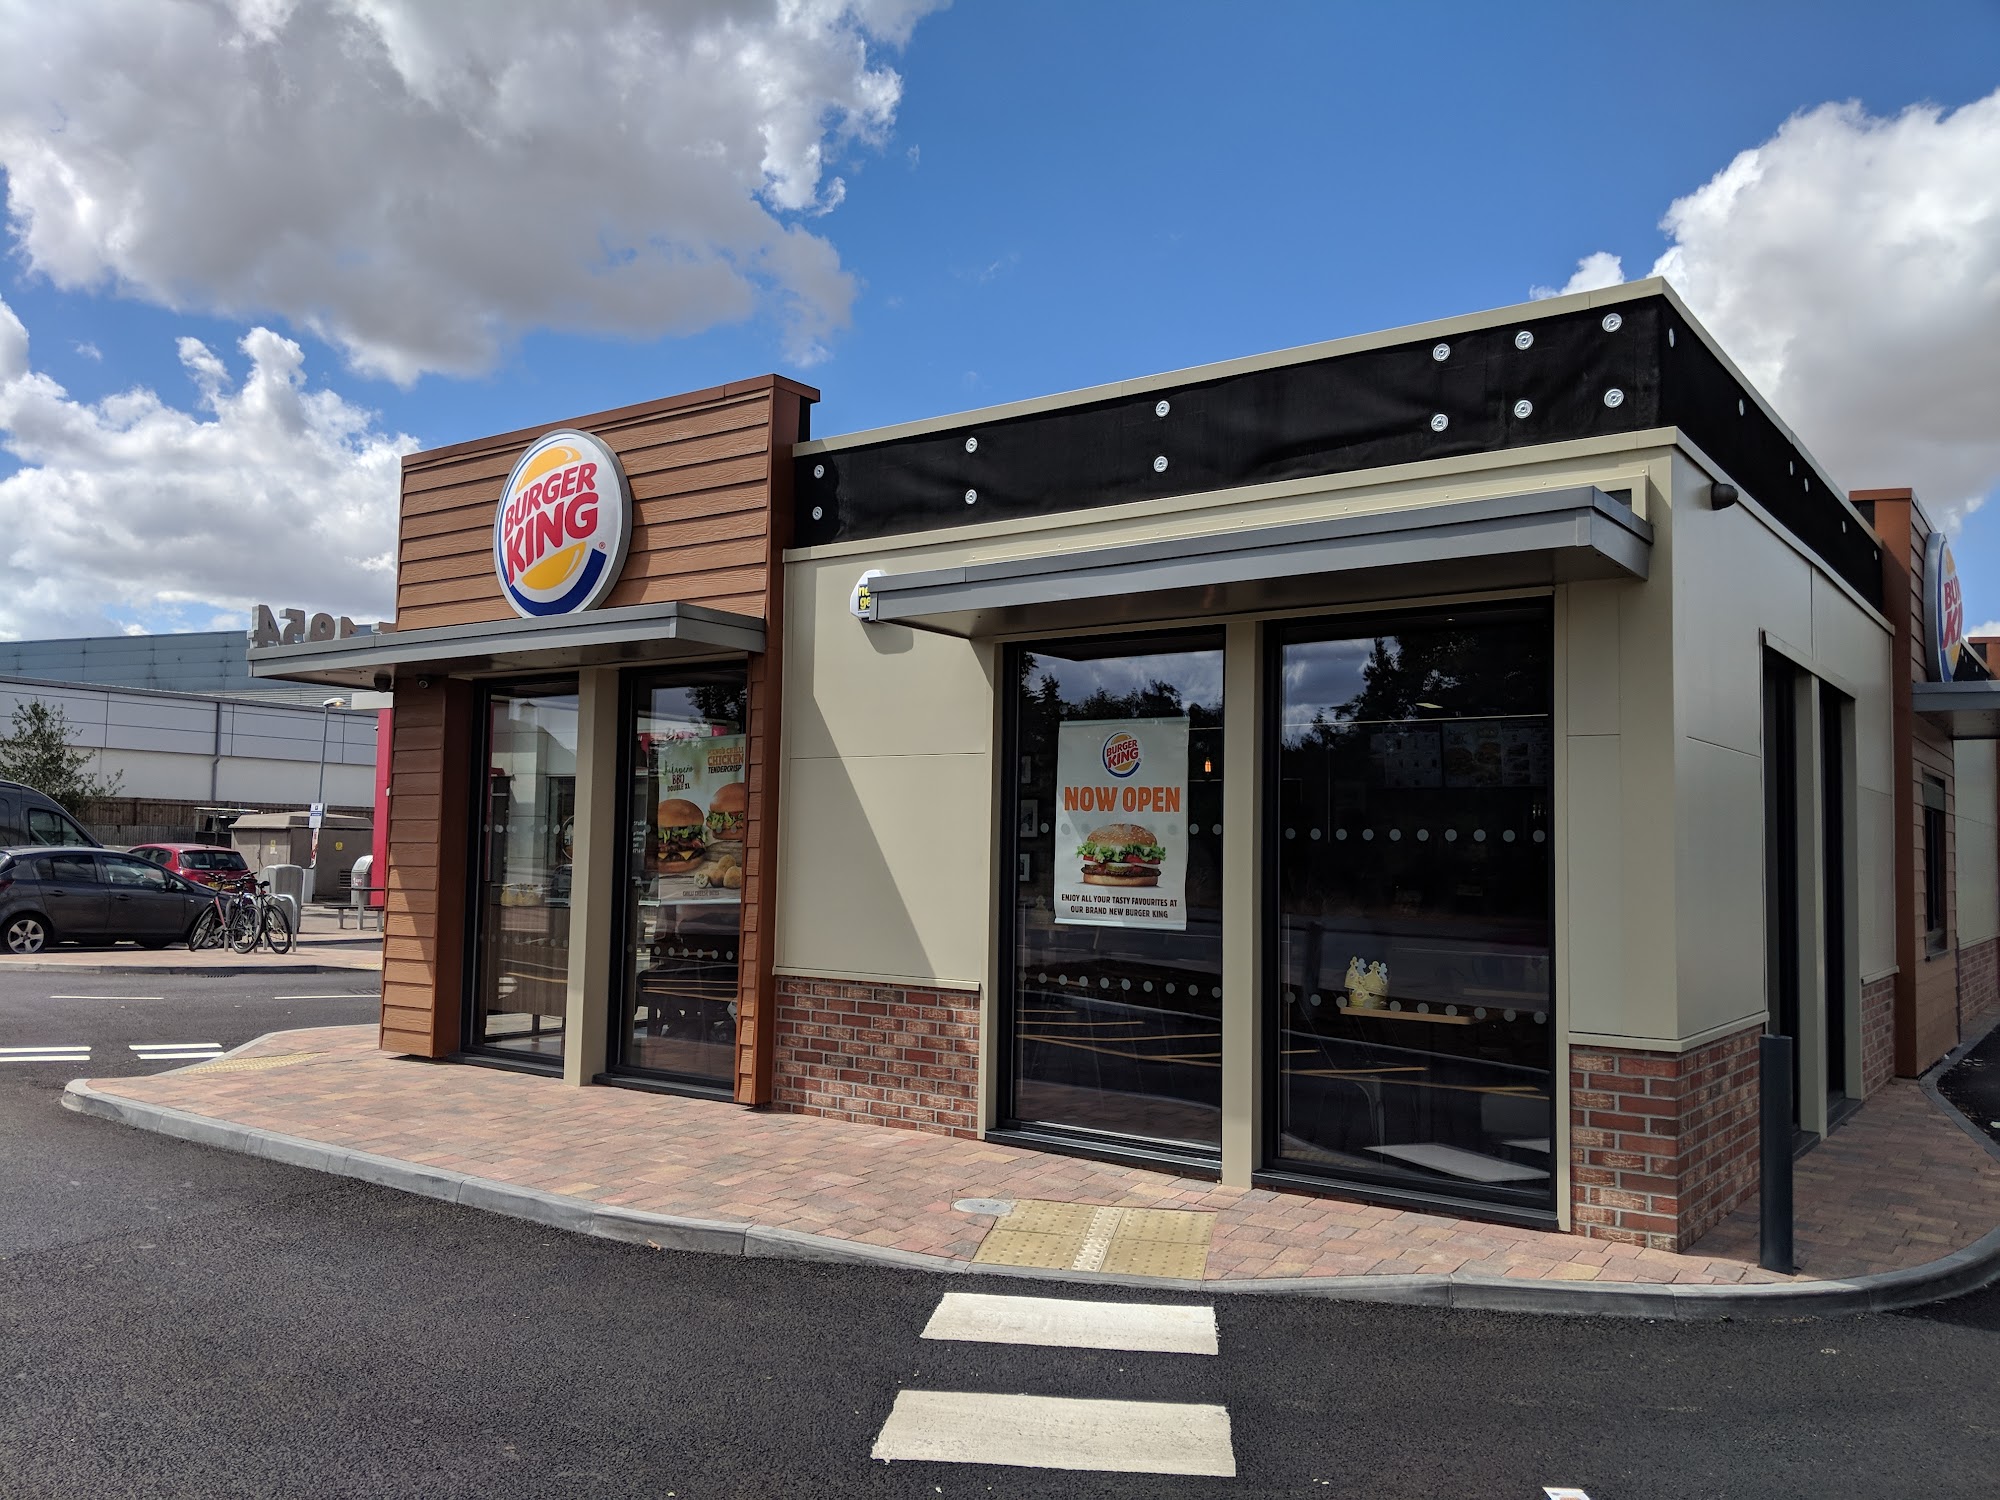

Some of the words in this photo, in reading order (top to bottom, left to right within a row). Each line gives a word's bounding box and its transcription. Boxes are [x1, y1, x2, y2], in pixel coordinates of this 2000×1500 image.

[504, 463, 597, 542] BURGER
[506, 492, 599, 586] KING
[1107, 739, 1138, 757] BURGER
[707, 753, 744, 766] CHICKEN
[1107, 747, 1139, 769] KING
[708, 764, 742, 774] TENDERCRISP
[667, 784, 684, 792] DOUBLE
[1064, 786, 1118, 812] NOW
[1122, 786, 1180, 812] OPEN
[1061, 893, 1080, 902] ENJOY
[1081, 894, 1092, 902] ALL
[1093, 895, 1111, 904] YOUR
[1112, 896, 1131, 905] TASTY
[1131, 897, 1168, 907] FAVOURITES
[1169, 899, 1177, 907] AT
[1070, 905, 1083, 913] OUR
[1085, 906, 1107, 915] BRAND
[1108, 907, 1124, 916] NEW
[1125, 908, 1150, 917] BURGER
[1151, 910, 1169, 918] KING
